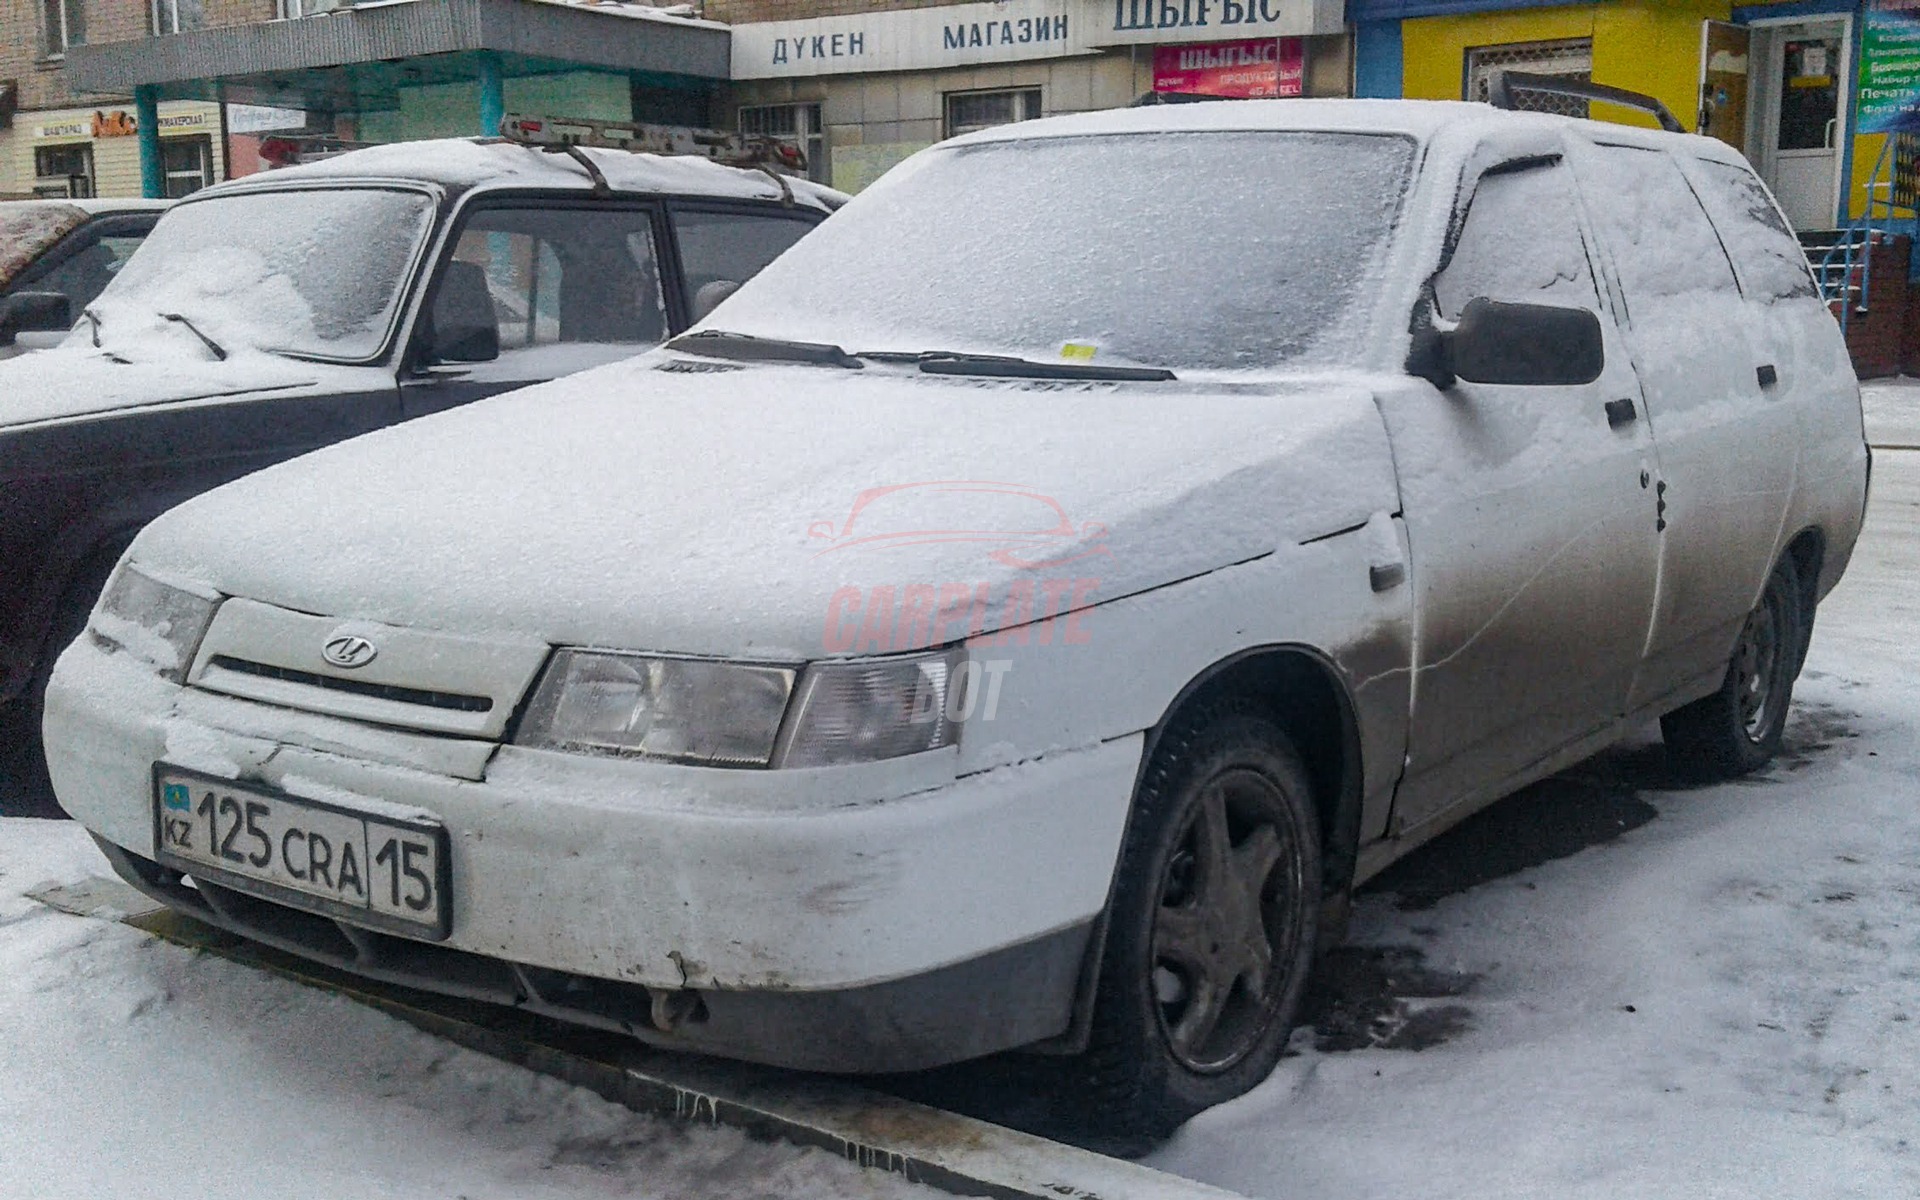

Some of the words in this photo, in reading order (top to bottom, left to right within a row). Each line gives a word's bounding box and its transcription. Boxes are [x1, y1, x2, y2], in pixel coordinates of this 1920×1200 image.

[943, 14, 1068, 50] МАГАЗИН
[1861, 88, 1914, 99] Печать
[164, 815, 193, 848] KZ
[197, 791, 273, 868] 125
[281, 827, 363, 896] CRA
[375, 837, 433, 912] 15
